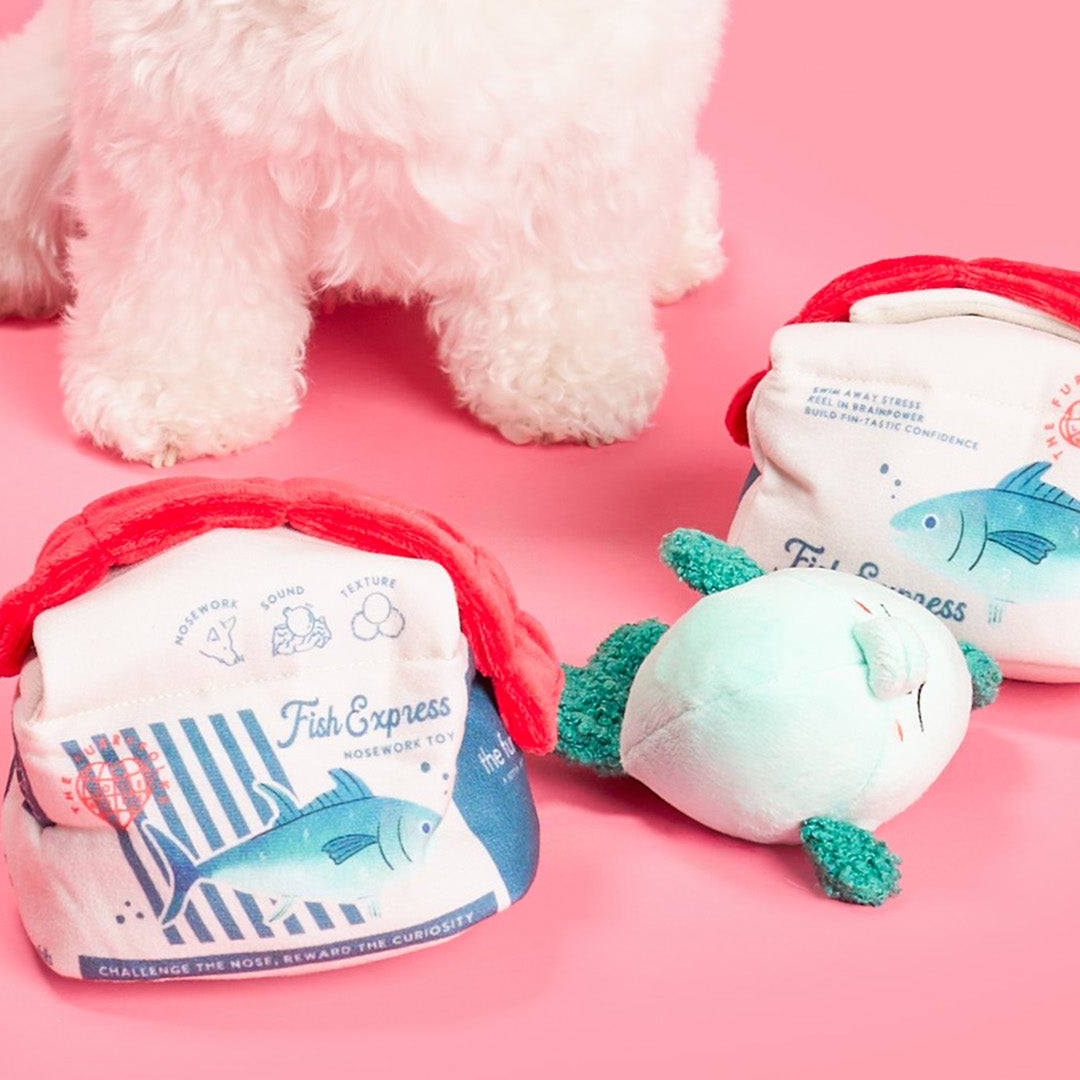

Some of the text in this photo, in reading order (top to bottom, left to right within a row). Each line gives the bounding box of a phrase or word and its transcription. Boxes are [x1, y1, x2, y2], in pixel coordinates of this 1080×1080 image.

[807, 395, 925, 422] REEL IN BRAINPOWER
[812, 386, 921, 410] SWIM AWAY STRESS
[804, 406, 837, 419] BUILD
[905, 425, 980, 451] CONFIDENCE
[260, 585, 305, 611] SOUND
[340, 575, 398, 599] TEXTURE
[174, 598, 239, 646] NOSEWORK
[277, 694, 452, 749] Fish Express
[344, 731, 456, 760] NOSEWORK TOY
[478, 747, 506, 775] the
[98, 965, 190, 978] CHALLENGE
[196, 960, 226, 973] THE
[283, 946, 351, 965] REWARD
[357, 938, 386, 953] THE
[392, 911, 475, 945] CURIOSITY
